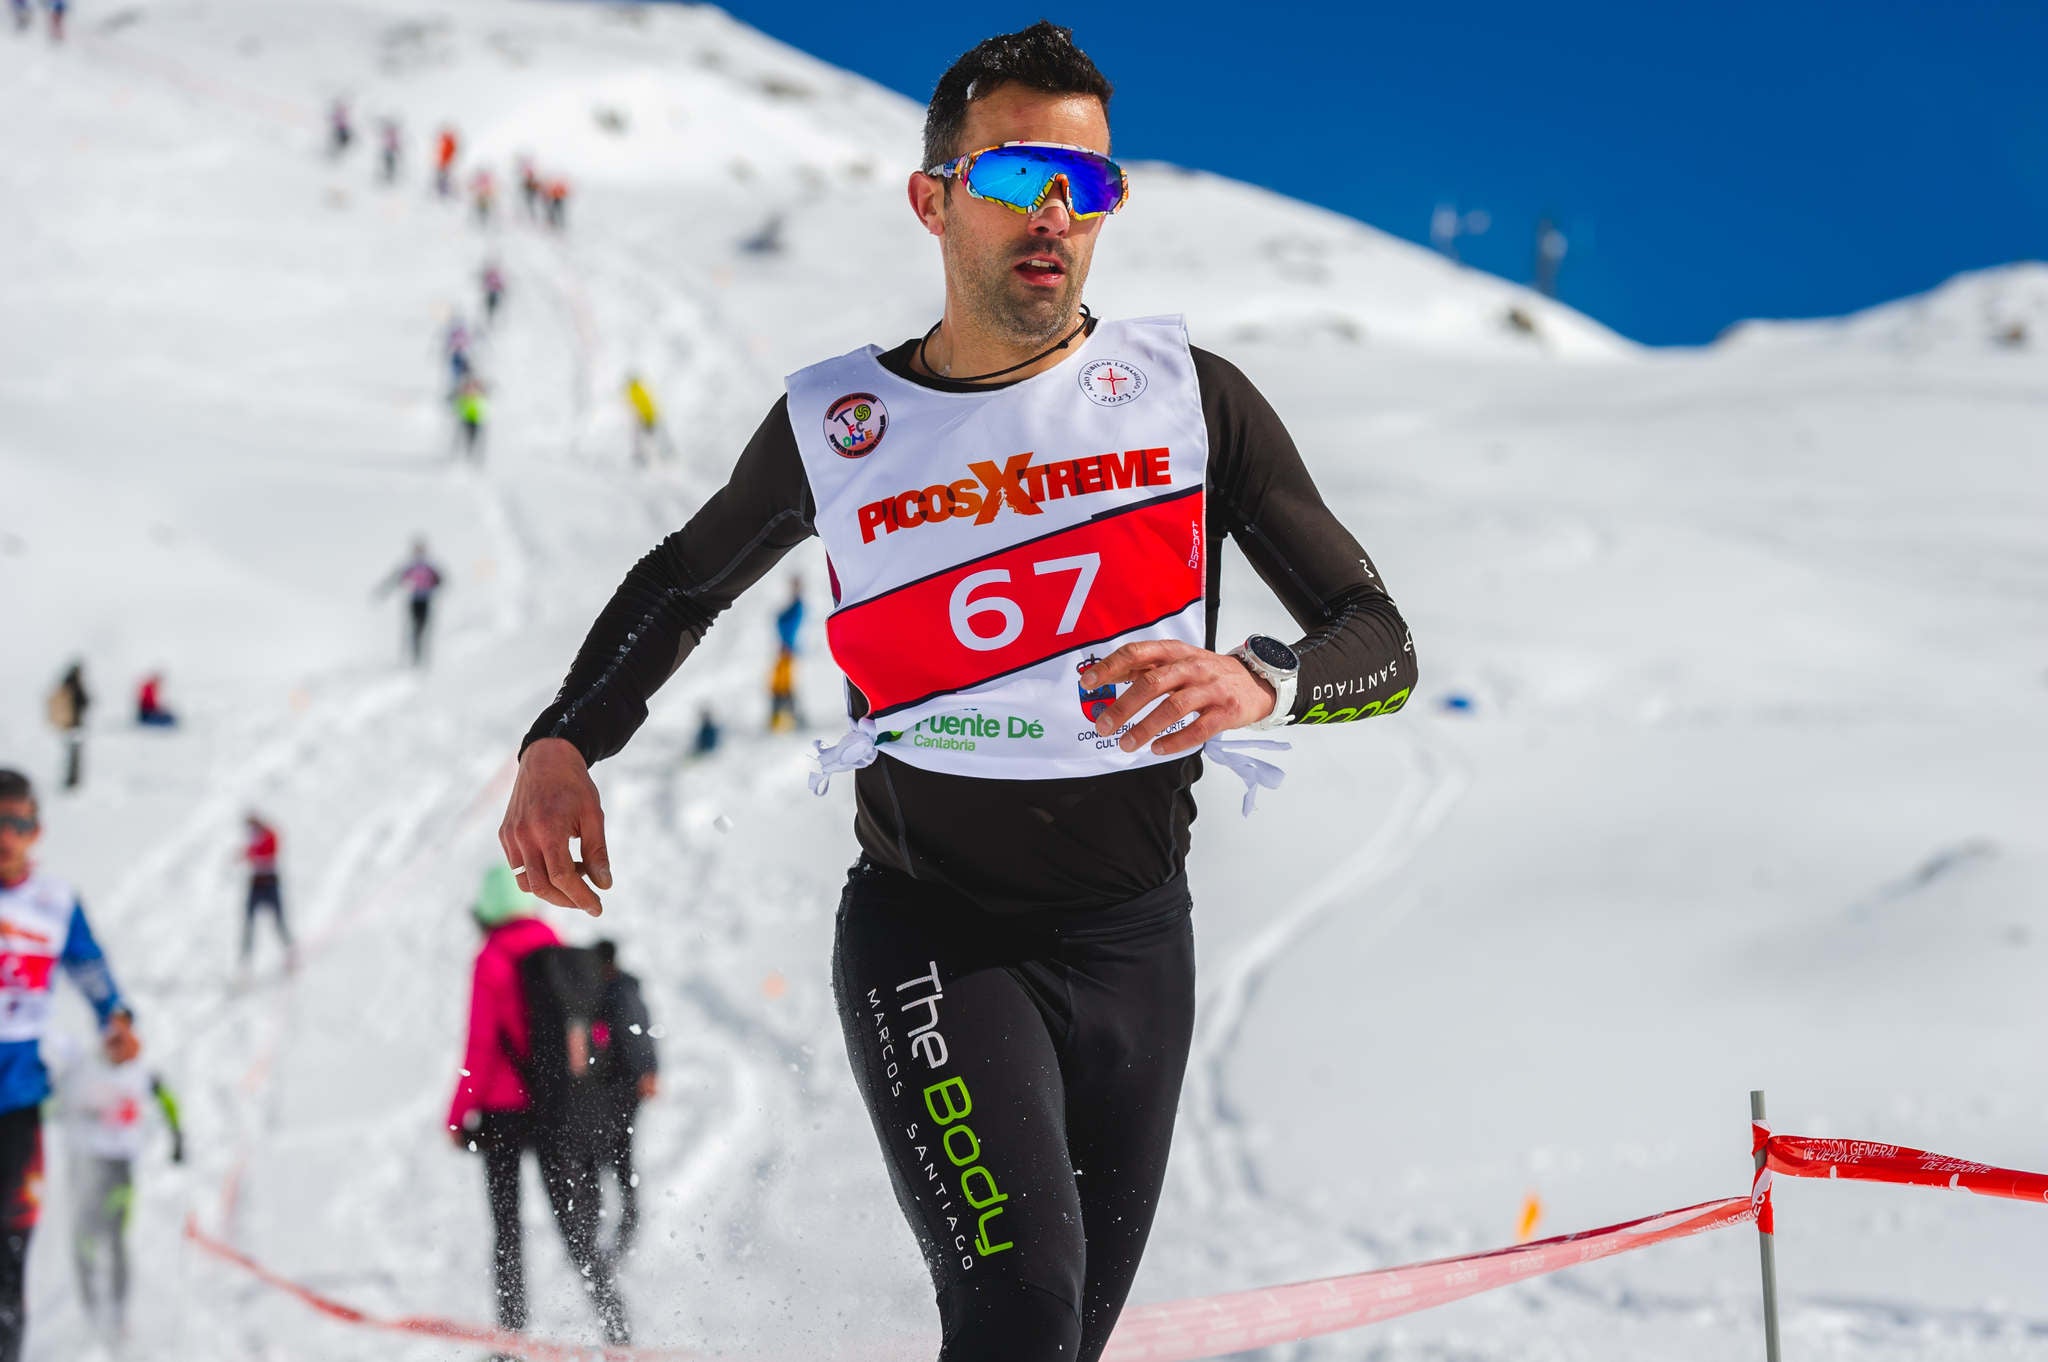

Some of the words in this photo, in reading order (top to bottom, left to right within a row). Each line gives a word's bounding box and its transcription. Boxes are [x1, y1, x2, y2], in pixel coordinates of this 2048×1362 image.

[1101, 393, 1132, 403] 2023
[949, 552, 1102, 652] 67
[1007, 716, 1044, 739] Dé
[1313, 660, 1397, 701] SANTIAGO
[914, 734, 976, 752] Cantabria
[866, 988, 903, 1097] MARCOS
[896, 960, 949, 1069] The
[906, 1123, 973, 1271] SANTIAGO
[923, 1076, 1014, 1257] Body
